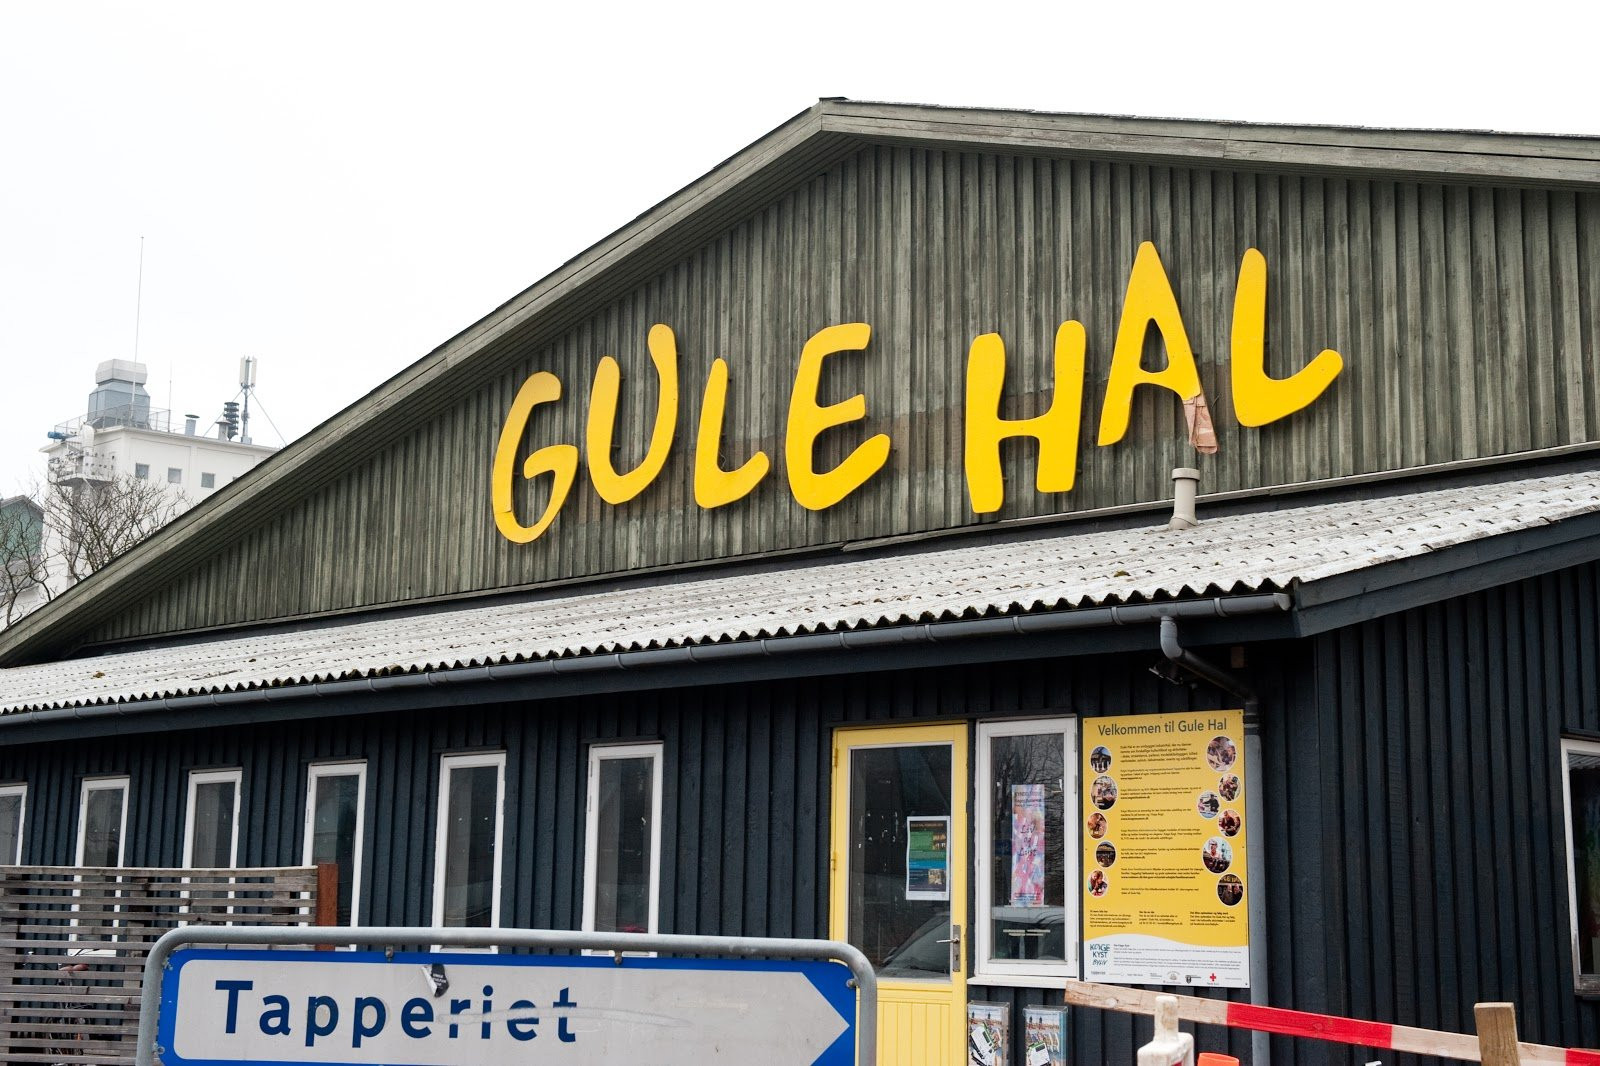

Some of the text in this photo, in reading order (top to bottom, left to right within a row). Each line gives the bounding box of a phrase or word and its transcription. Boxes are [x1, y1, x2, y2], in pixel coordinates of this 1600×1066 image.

[492, 241, 1344, 544] GULE HAL
[1098, 718, 1227, 736] Velkommen til Gule Hal
[215, 980, 577, 1048] Tapperiet
